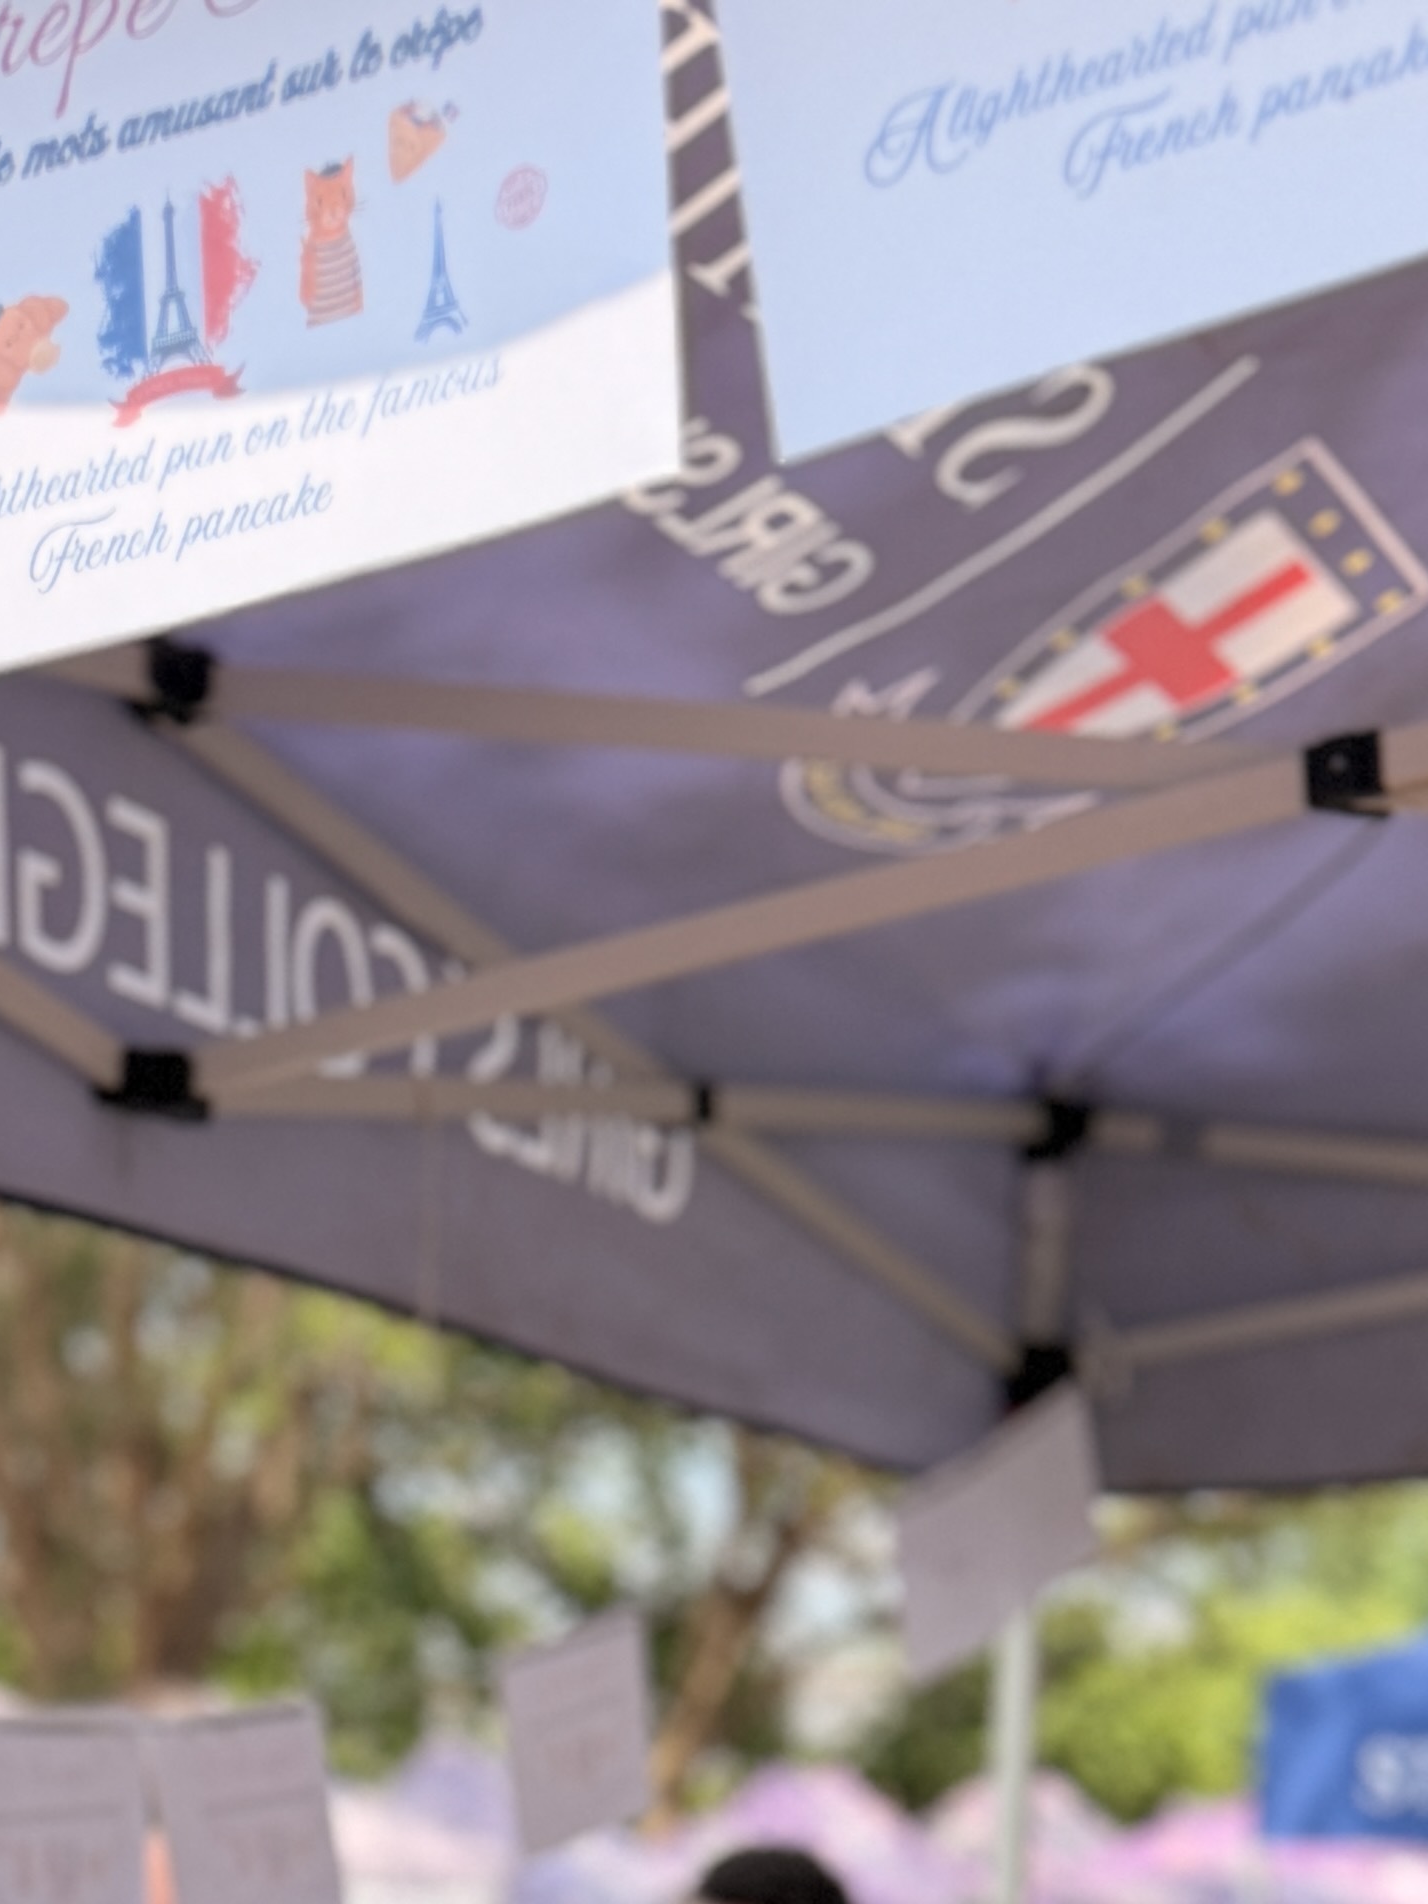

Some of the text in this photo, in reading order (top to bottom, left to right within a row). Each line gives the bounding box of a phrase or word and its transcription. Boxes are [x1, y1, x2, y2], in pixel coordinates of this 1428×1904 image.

[23, 111, 111, 177] mots
[117, 58, 280, 151] amusant
[1063, 85, 1242, 200] French
[159, 428, 236, 491] pun
[244, 415, 293, 457] on
[299, 393, 358, 448] the
[361, 352, 505, 439] famous
[28, 473, 335, 595] French pancake
